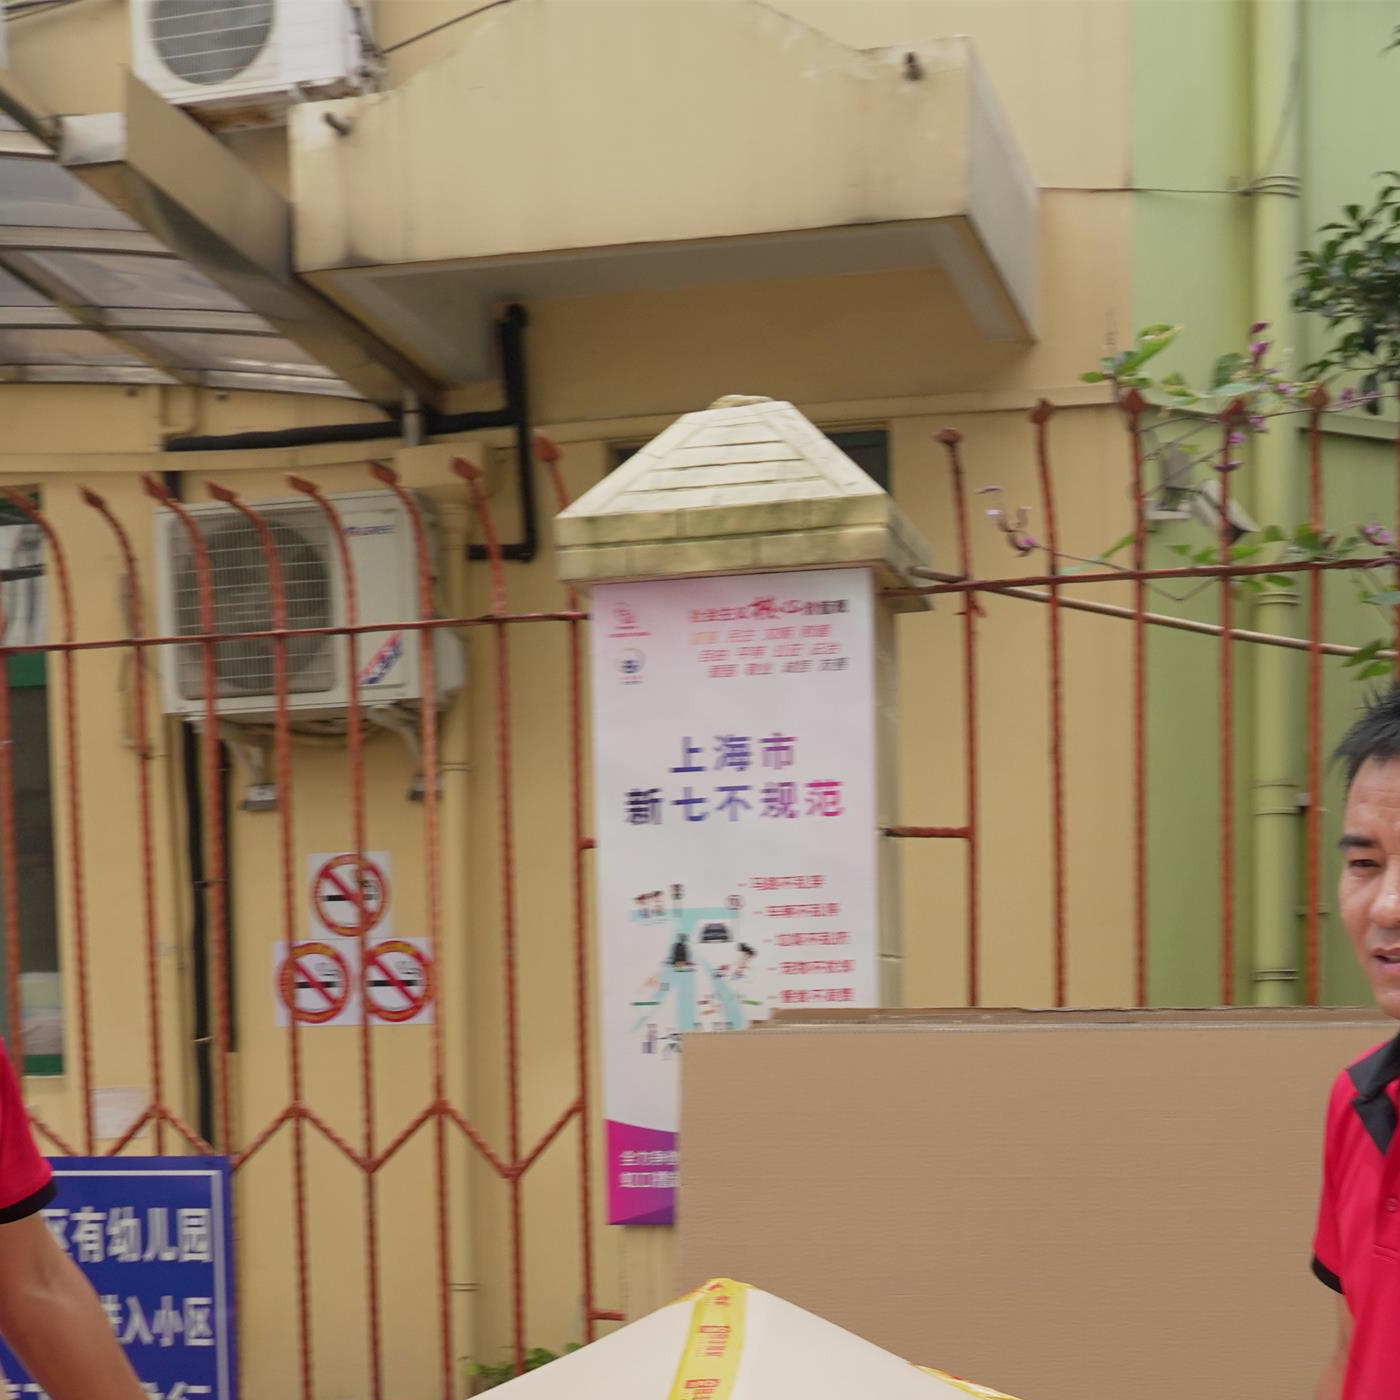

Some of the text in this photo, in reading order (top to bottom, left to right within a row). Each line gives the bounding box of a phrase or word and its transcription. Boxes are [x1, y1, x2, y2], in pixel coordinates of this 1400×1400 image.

[669, 732, 798, 773] 上海市
[624, 779, 844, 825] 新七不规范
